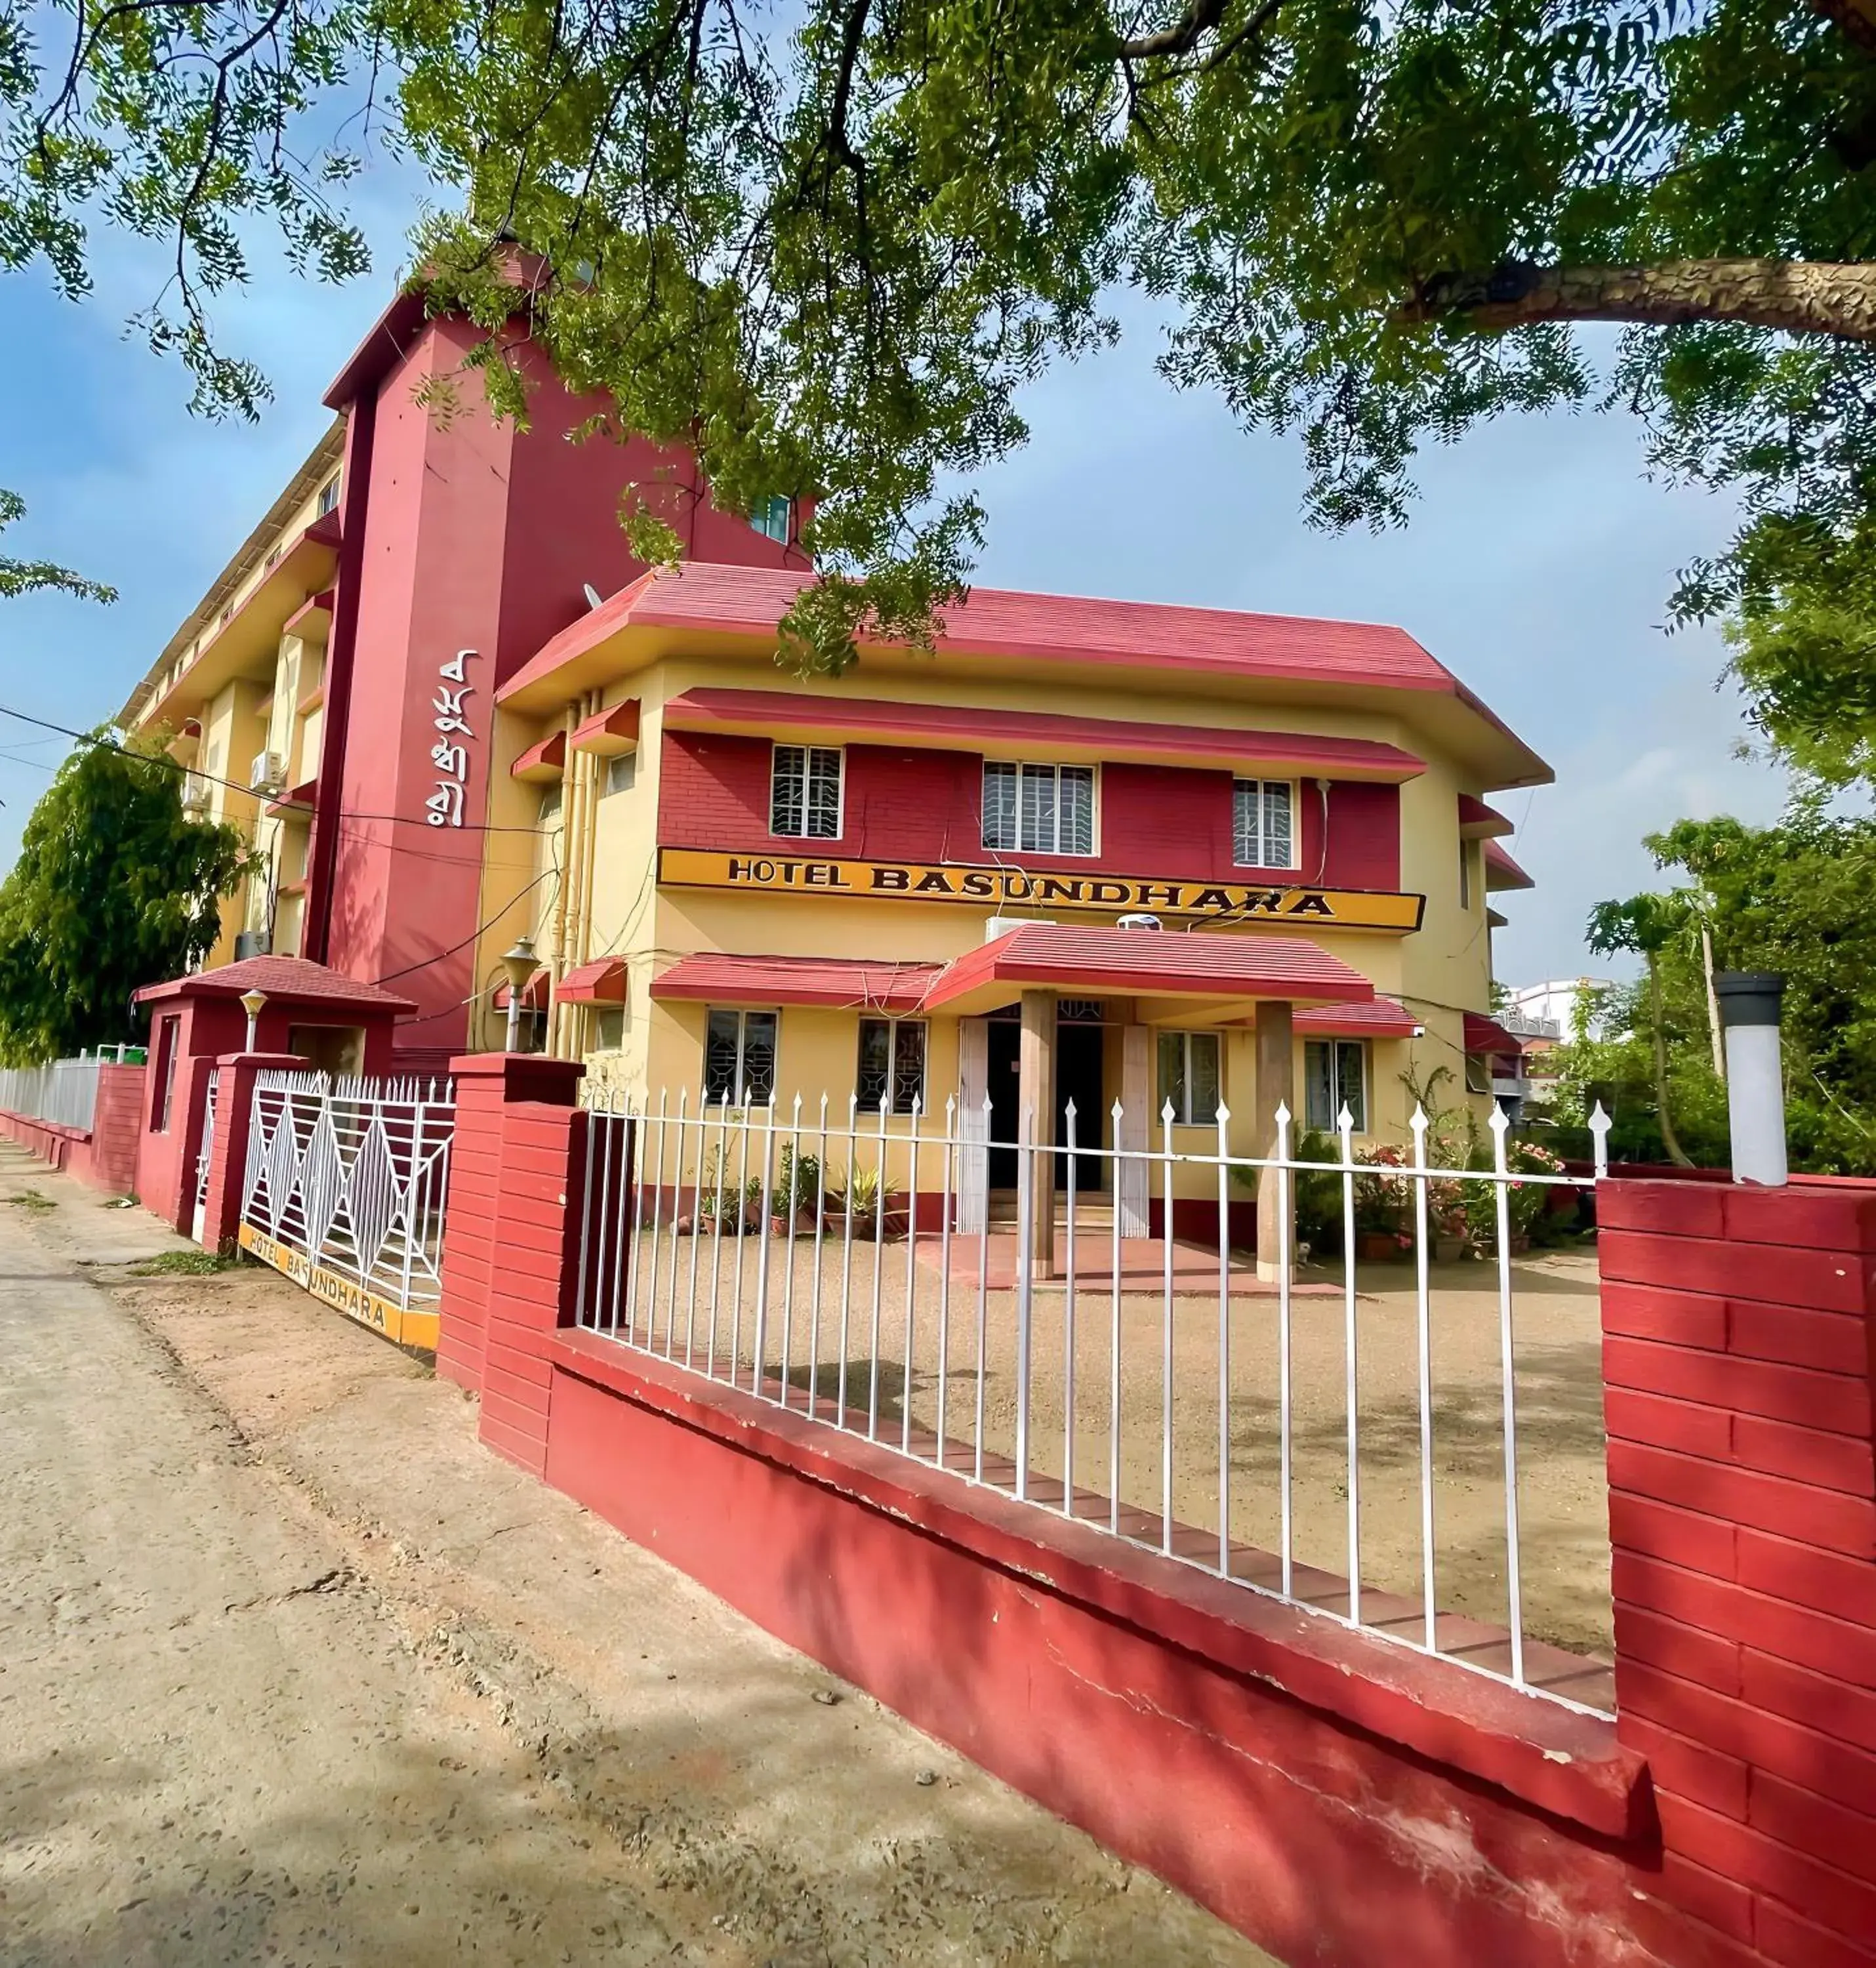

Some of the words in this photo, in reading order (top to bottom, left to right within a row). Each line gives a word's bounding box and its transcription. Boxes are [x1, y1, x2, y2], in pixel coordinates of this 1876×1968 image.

[729, 859, 852, 888] HOTEL
[870, 868, 1336, 916] BASUNDHARA
[251, 1233, 279, 1263] HOTEL
[287, 1256, 385, 1327] BASUNDHARA
